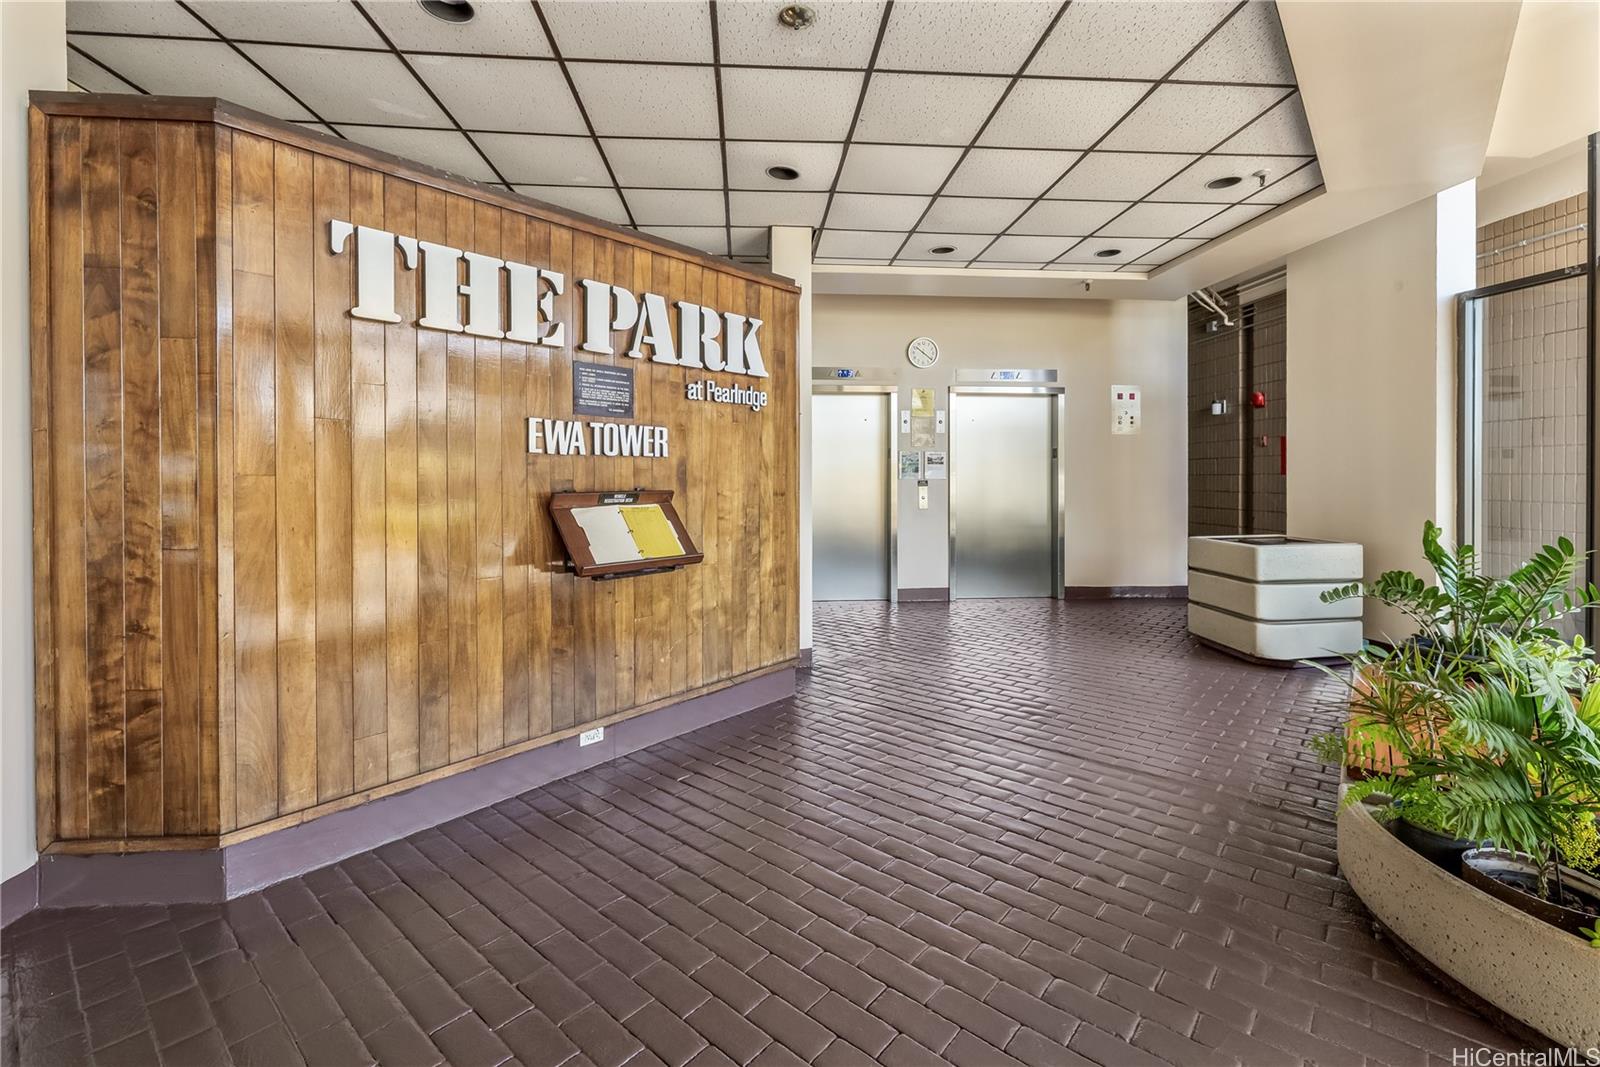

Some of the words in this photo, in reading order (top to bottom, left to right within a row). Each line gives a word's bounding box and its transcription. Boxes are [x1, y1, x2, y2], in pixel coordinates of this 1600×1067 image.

[329, 219, 565, 348] THE
[580, 278, 769, 377] PARK
[686, 380, 704, 401] at
[527, 416, 586, 455] EWA
[589, 422, 669, 458] TOWER
